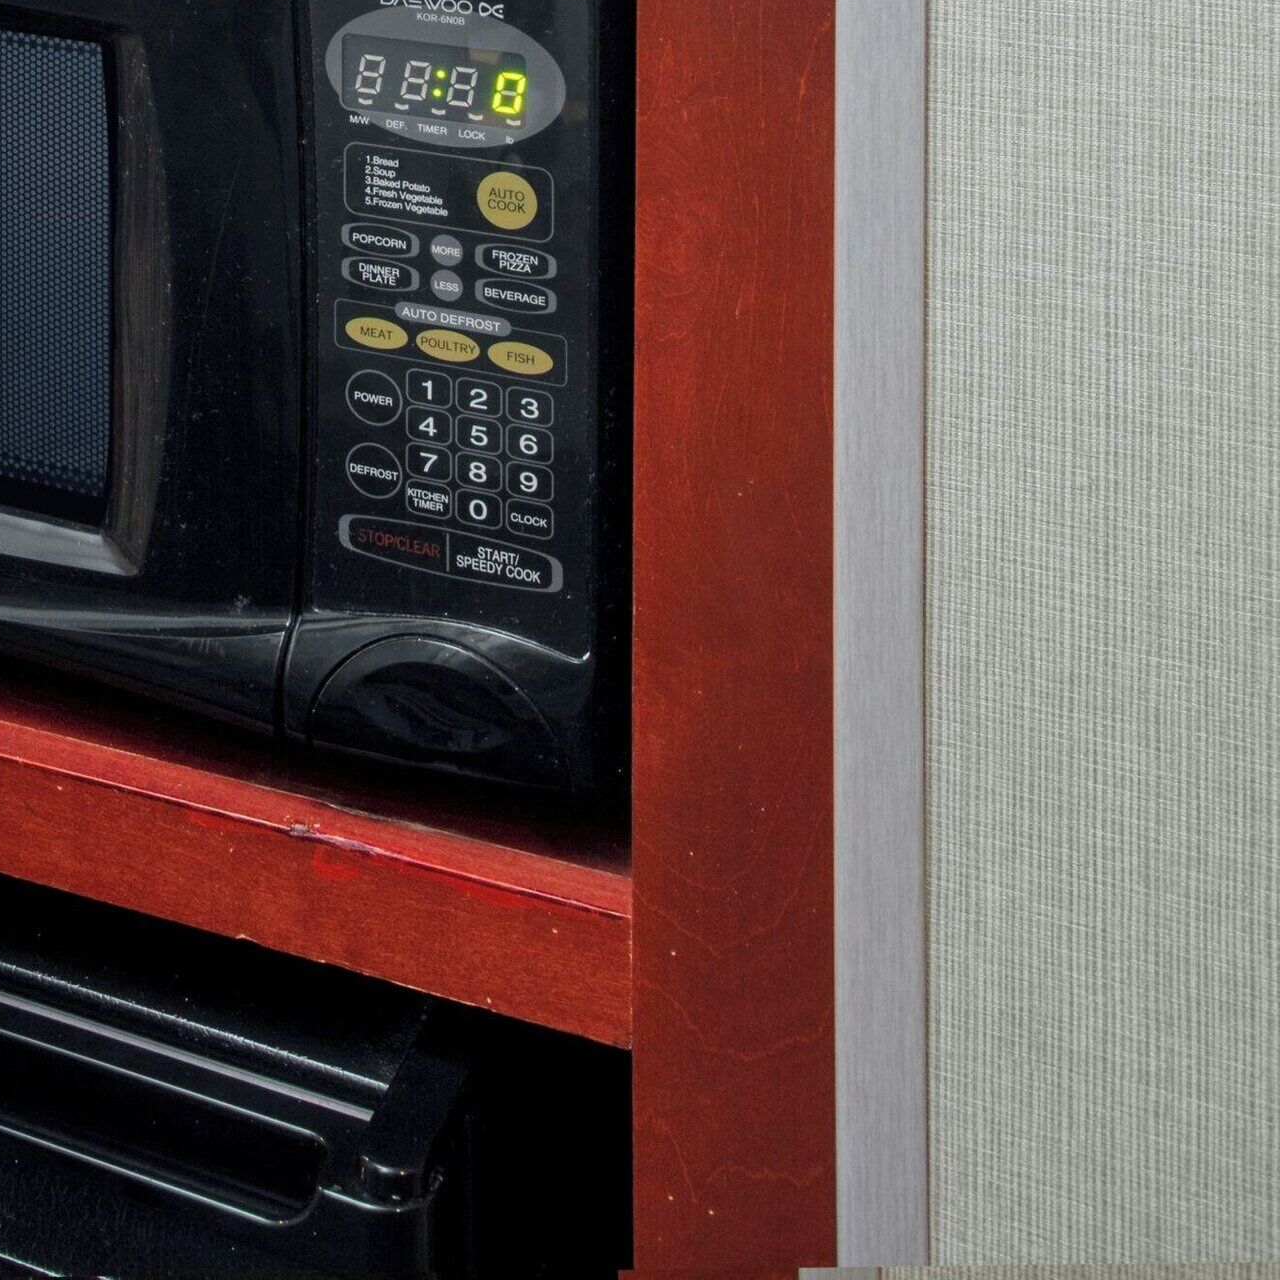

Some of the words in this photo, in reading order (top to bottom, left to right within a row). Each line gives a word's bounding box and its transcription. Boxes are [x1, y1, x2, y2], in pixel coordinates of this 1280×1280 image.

[349, 115, 370, 125] M/W
[417, 123, 448, 135] TIMER
[458, 129, 486, 141] LOCK
[402, 180, 431, 193] Potato
[400, 191, 443, 206] Vegetable
[488, 188, 525, 202] AUTO
[404, 202, 448, 217] Vegetable
[487, 199, 526, 214] COOK
[352, 233, 407, 249] POPCORN
[432, 245, 461, 257] MORE
[492, 250, 539, 265] FROZEN
[359, 263, 400, 277] DINNER
[499, 260, 532, 274] PIZZA
[362, 272, 396, 286] PLATE
[434, 280, 459, 293] LESS
[484, 287, 546, 306] BEVERAGE
[402, 306, 437, 322] AUTO
[440, 313, 501, 332] DEFROST
[360, 326, 393, 341] MEAT
[420, 336, 477, 355] POULTRY
[507, 351, 535, 366] FISH
[354, 390, 393, 407] POWER
[421, 380, 433, 401] 1
[469, 388, 488, 410] 2
[520, 397, 539, 419] 3
[419, 416, 438, 437] 4
[470, 425, 489, 446] 5
[519, 433, 539, 455] 6
[349, 462, 399, 481] DEFROST
[420, 451, 439, 473] 7
[469, 461, 488, 483] 8
[519, 471, 538, 493] 9
[407, 487, 449, 504] KITCHEN
[413, 497, 444, 512] TIMER
[469, 499, 488, 520] 0
[510, 512, 548, 528] CLOCK
[477, 547, 520, 566] START/
[456, 556, 504, 575] SPEEDY
[506, 565, 541, 583] COOK
